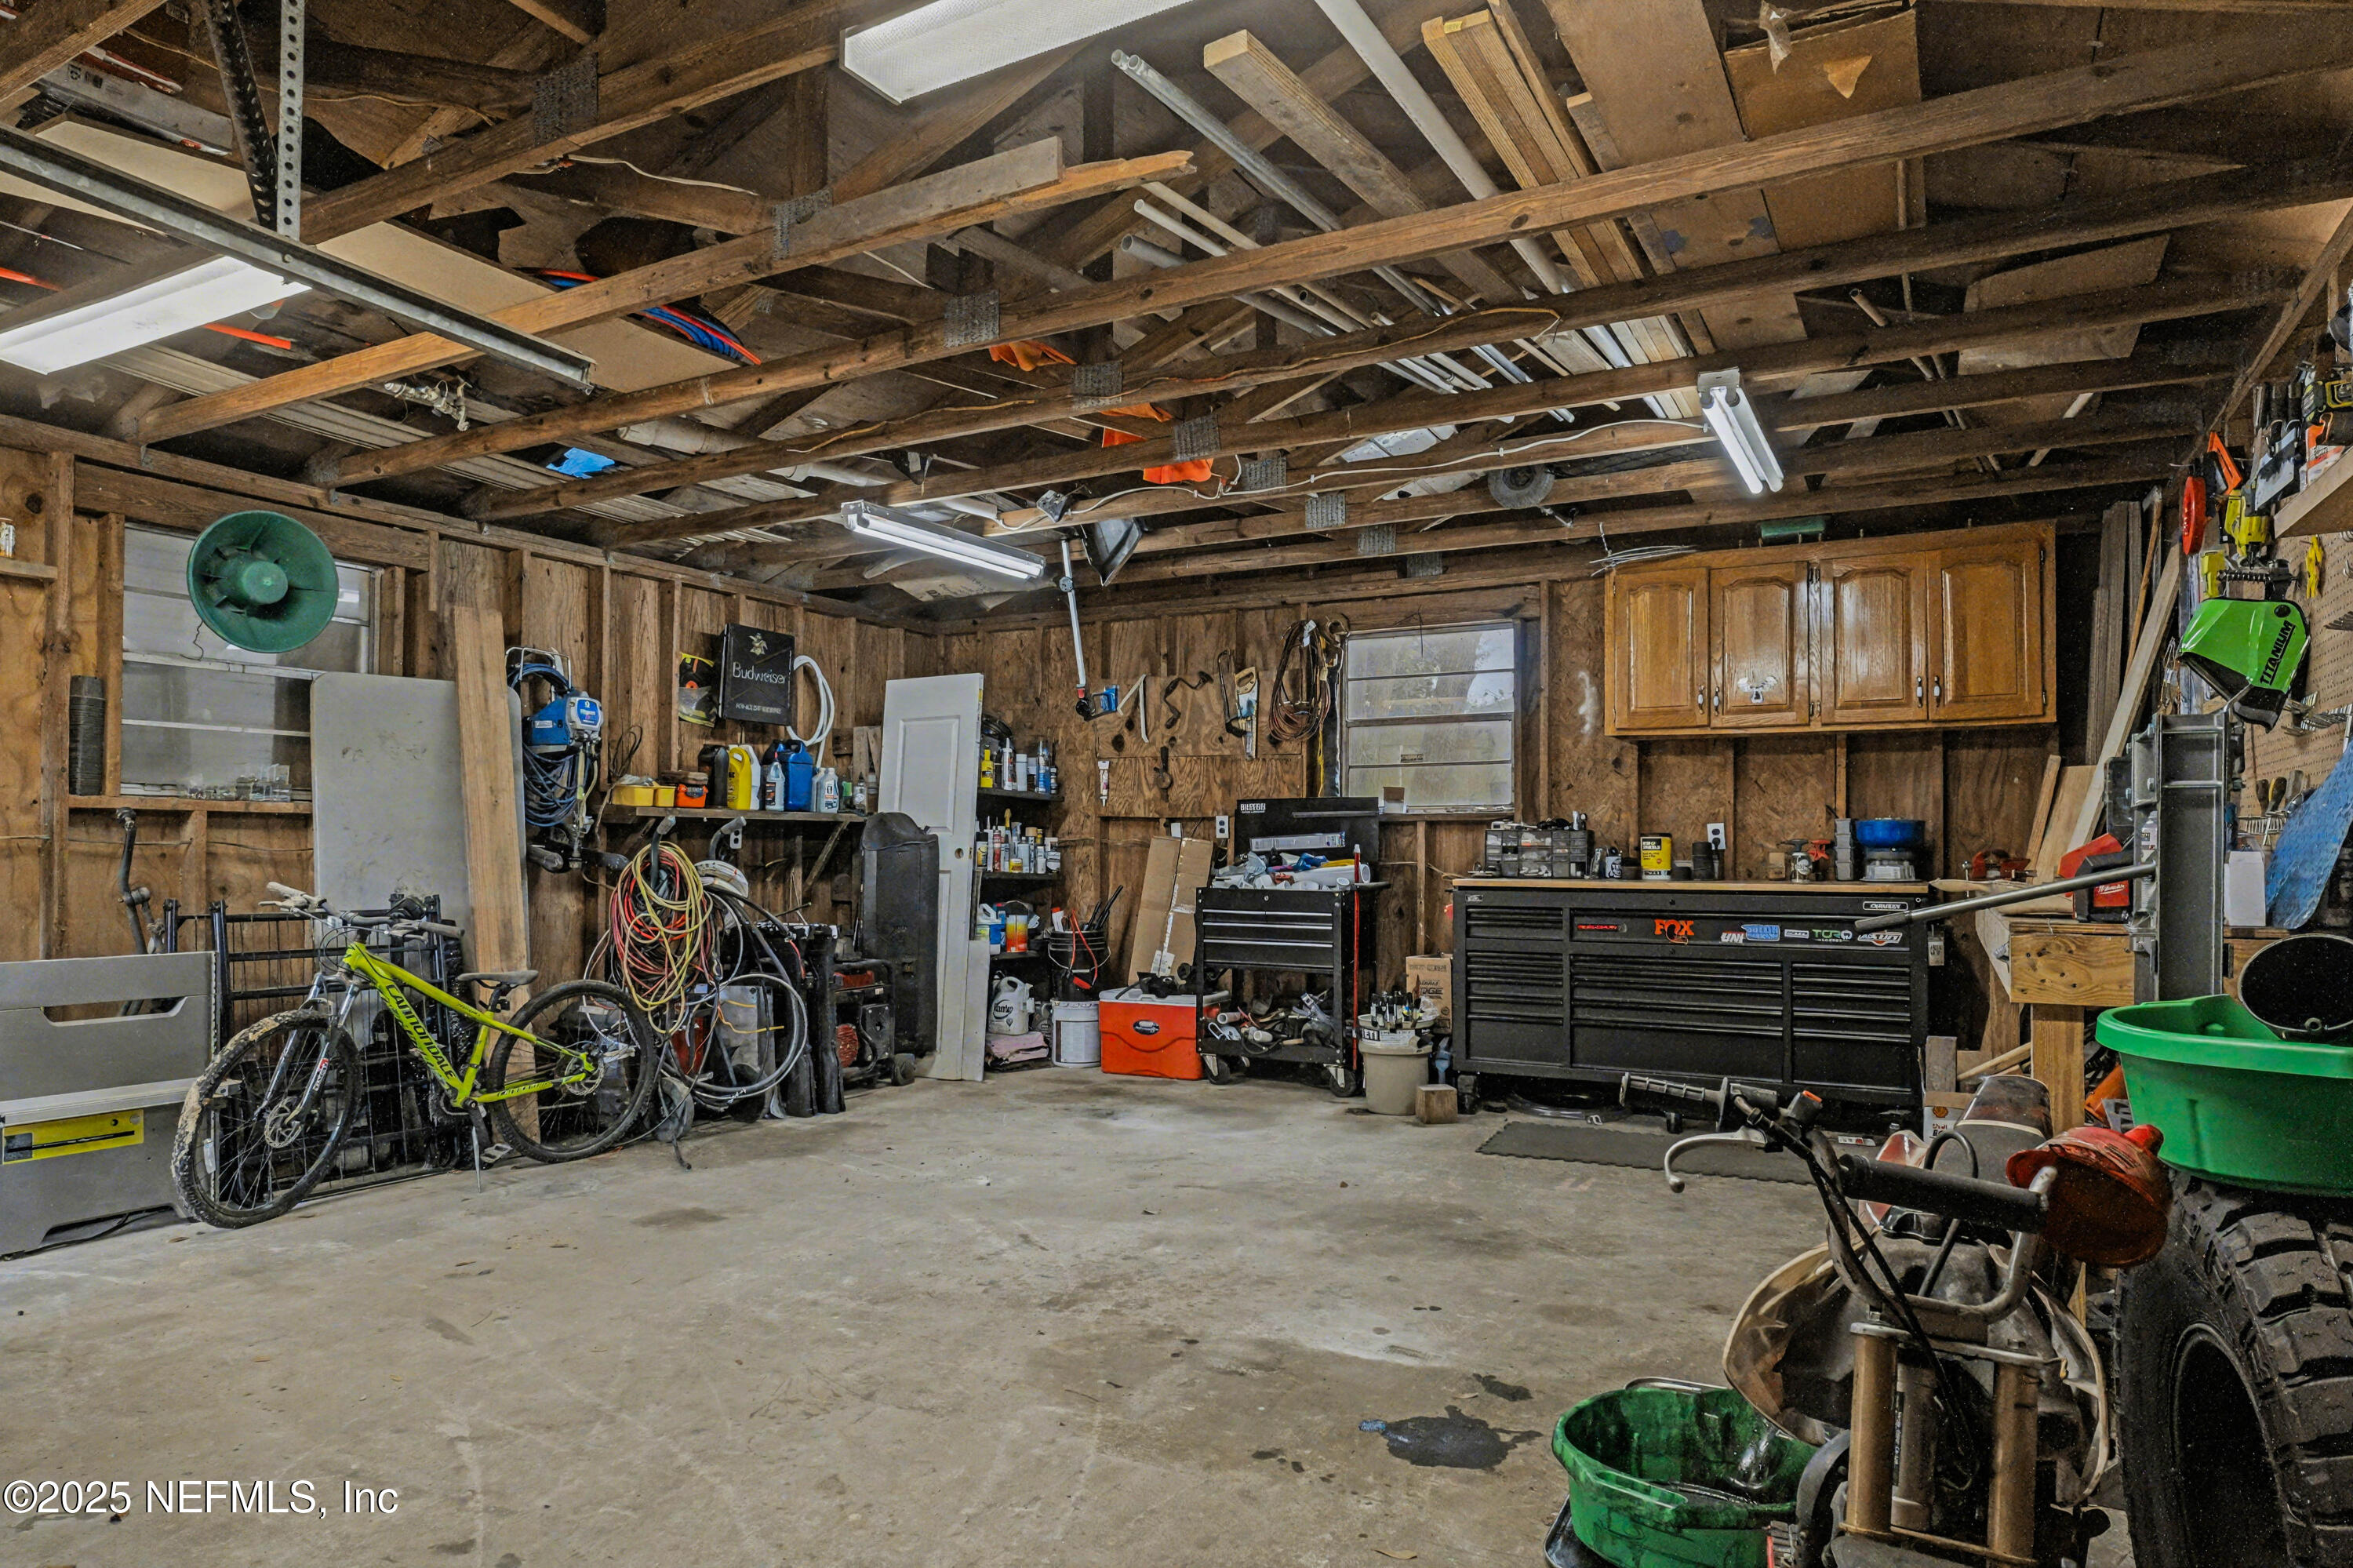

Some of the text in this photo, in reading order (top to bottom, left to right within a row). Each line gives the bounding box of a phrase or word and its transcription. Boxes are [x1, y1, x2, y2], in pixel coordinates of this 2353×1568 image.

[2260, 620, 2295, 684] TITANIUM
[733, 662, 786, 684] Budweiser
[1654, 919, 1694, 936] FOX
